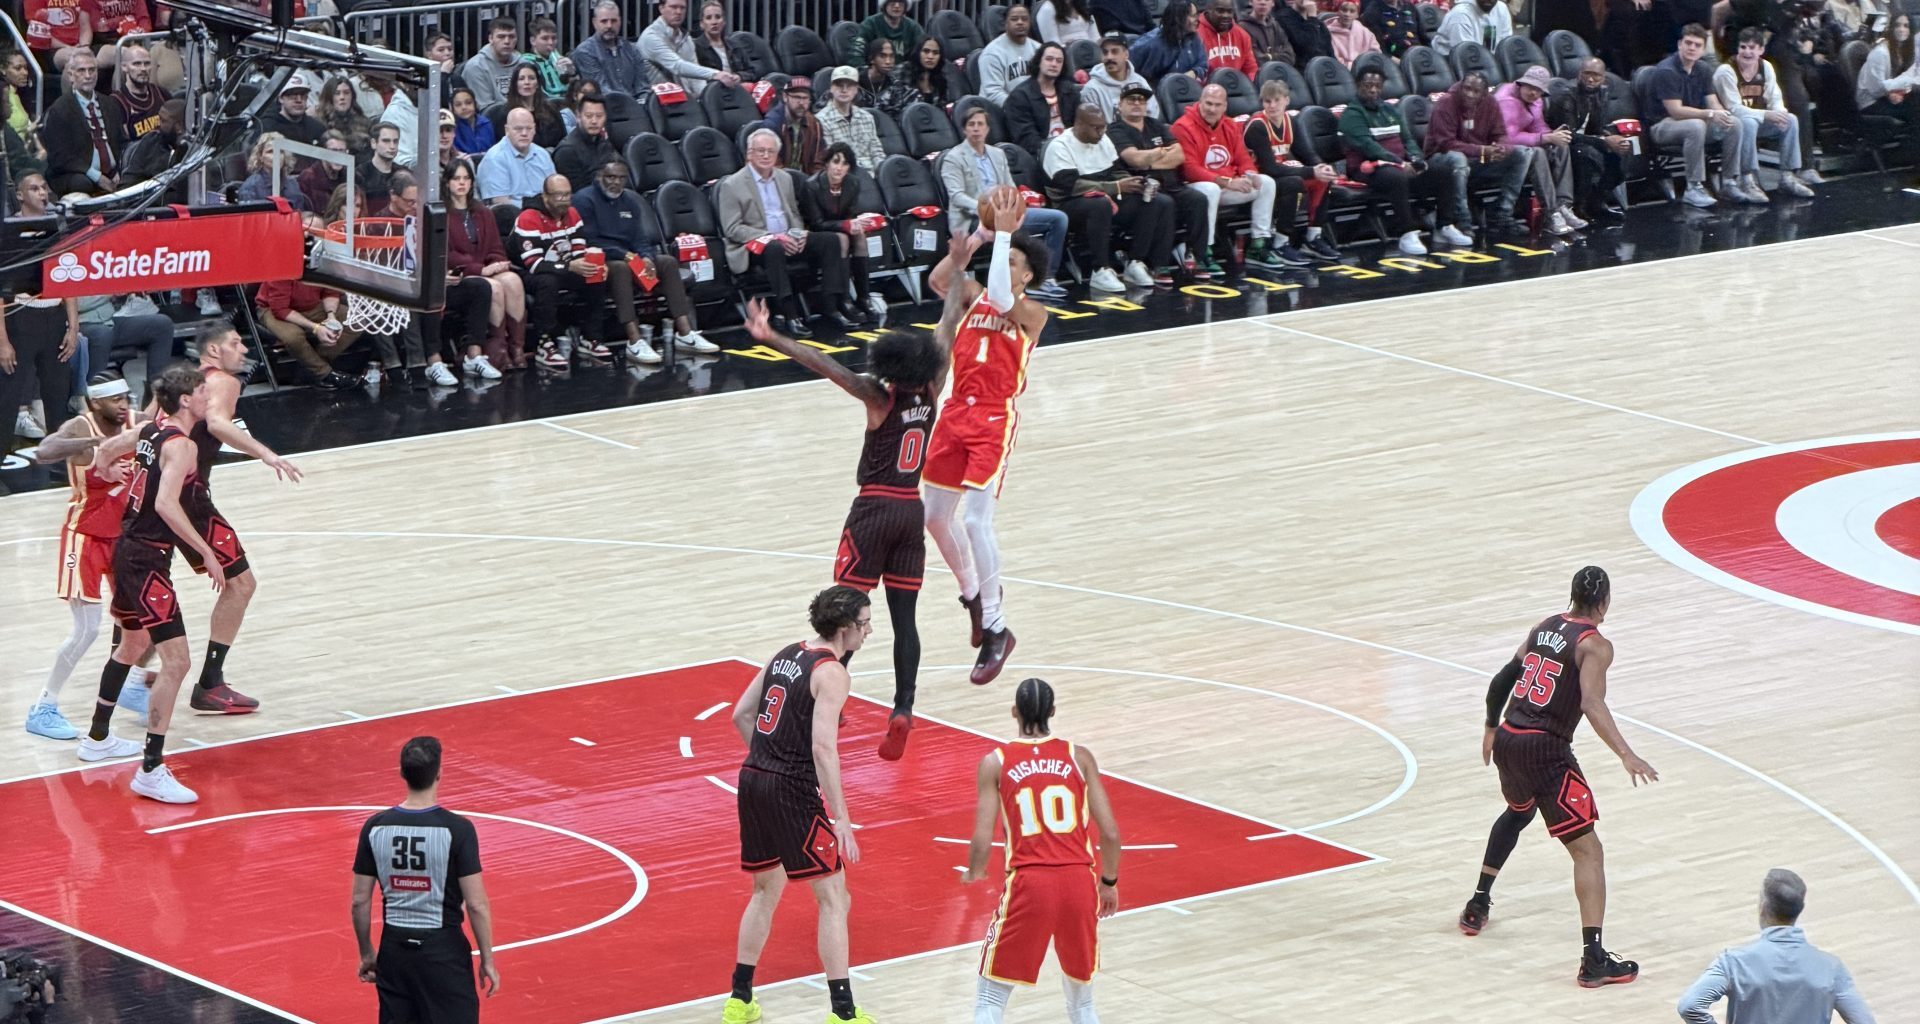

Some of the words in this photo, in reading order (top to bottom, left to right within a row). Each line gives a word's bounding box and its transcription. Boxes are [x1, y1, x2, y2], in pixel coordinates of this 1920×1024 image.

[133, 114, 161, 138] HAW
[1318, 243, 1554, 280] TRUE
[1179, 277, 1304, 299] TO
[966, 313, 1018, 341] ATLANTA
[975, 336, 990, 364] 1
[897, 428, 925, 473] 0
[1537, 631, 1568, 654] OKORO
[772, 658, 803, 683] GIDDEY
[1513, 652, 1564, 707] 35
[756, 684, 787, 735] 3
[1007, 759, 1073, 784] RISACHER
[1015, 784, 1078, 837] 10
[391, 835, 426, 871] 35
[393, 877, 429, 888] Emirates
